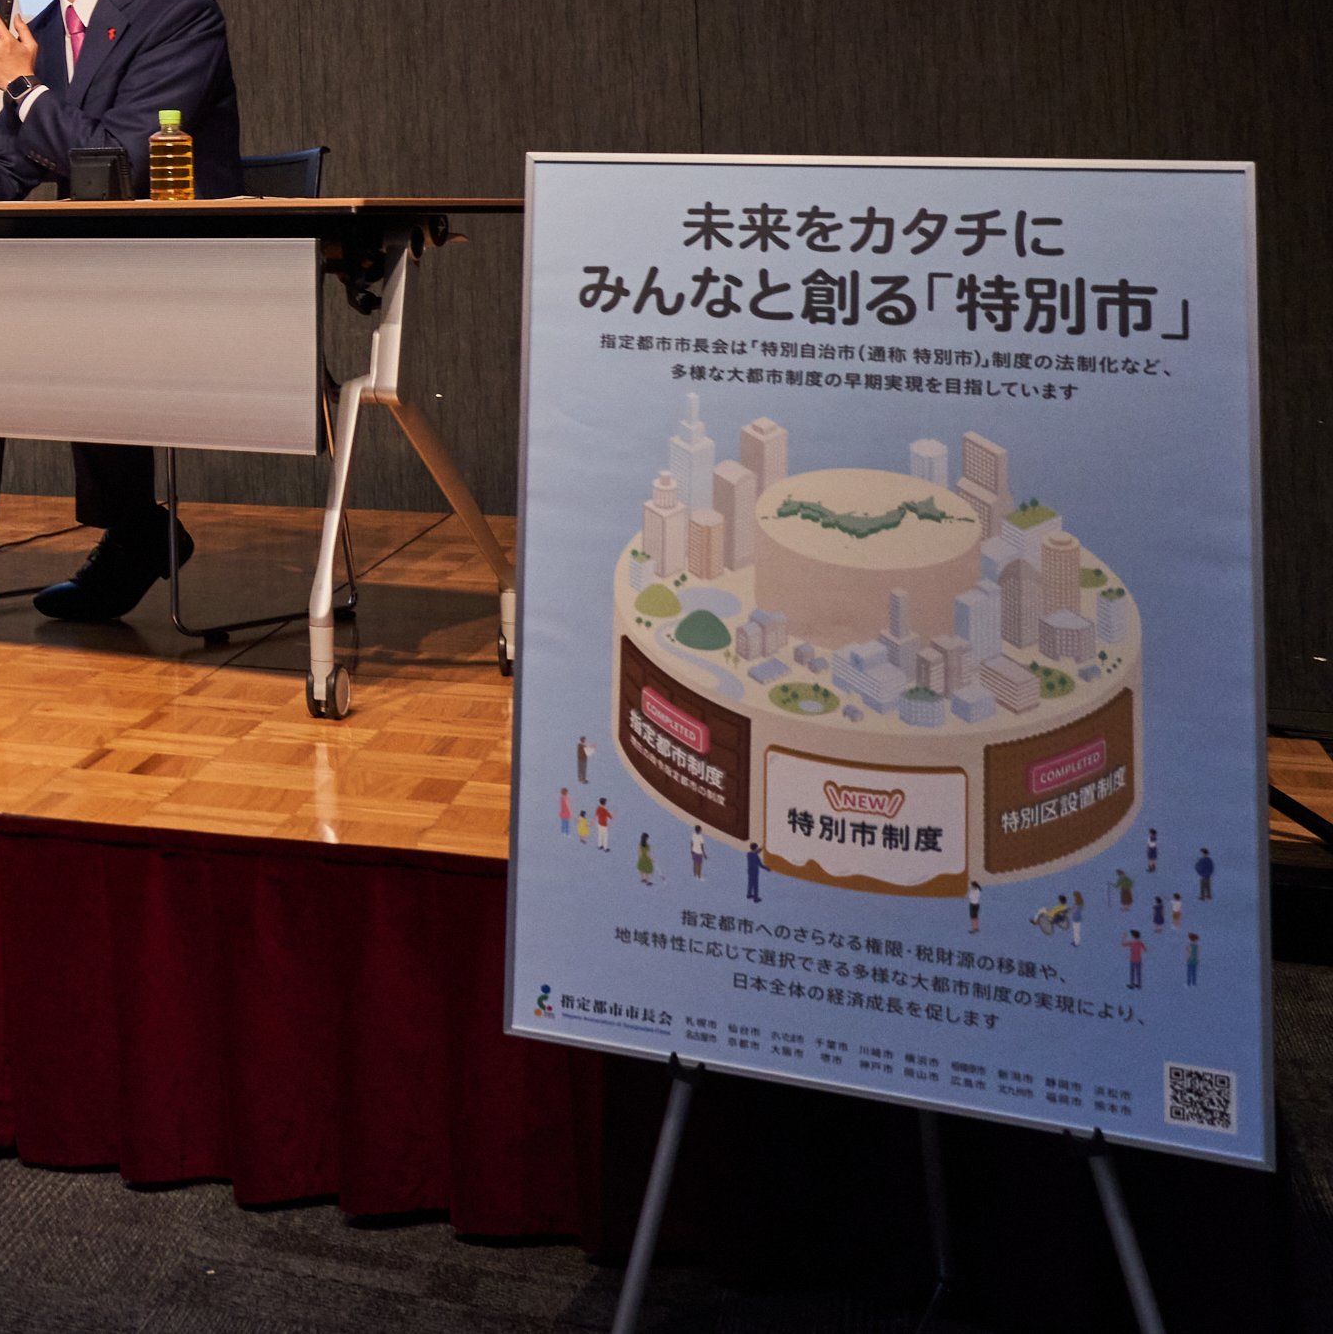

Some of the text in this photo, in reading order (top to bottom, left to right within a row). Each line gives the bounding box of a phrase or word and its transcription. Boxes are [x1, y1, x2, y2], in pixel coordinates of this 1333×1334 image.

[682, 201, 1065, 258] 未来をカタチに
[578, 266, 1191, 341] みんなと創る「特別市」
[671, 363, 1078, 400] 多様な大都市制度の早期実現を目指しています
[629, 709, 726, 790] 指定都市制度
[1040, 752, 1101, 784] COMPLETED
[843, 793, 887, 810] NEW
[1001, 766, 1126, 834] 特別区設置制度
[787, 807, 944, 853] 特別市制度
[560, 994, 673, 1027] 指定都市市長会
[733, 972, 999, 1029] 日本全体の経済成長を促します
